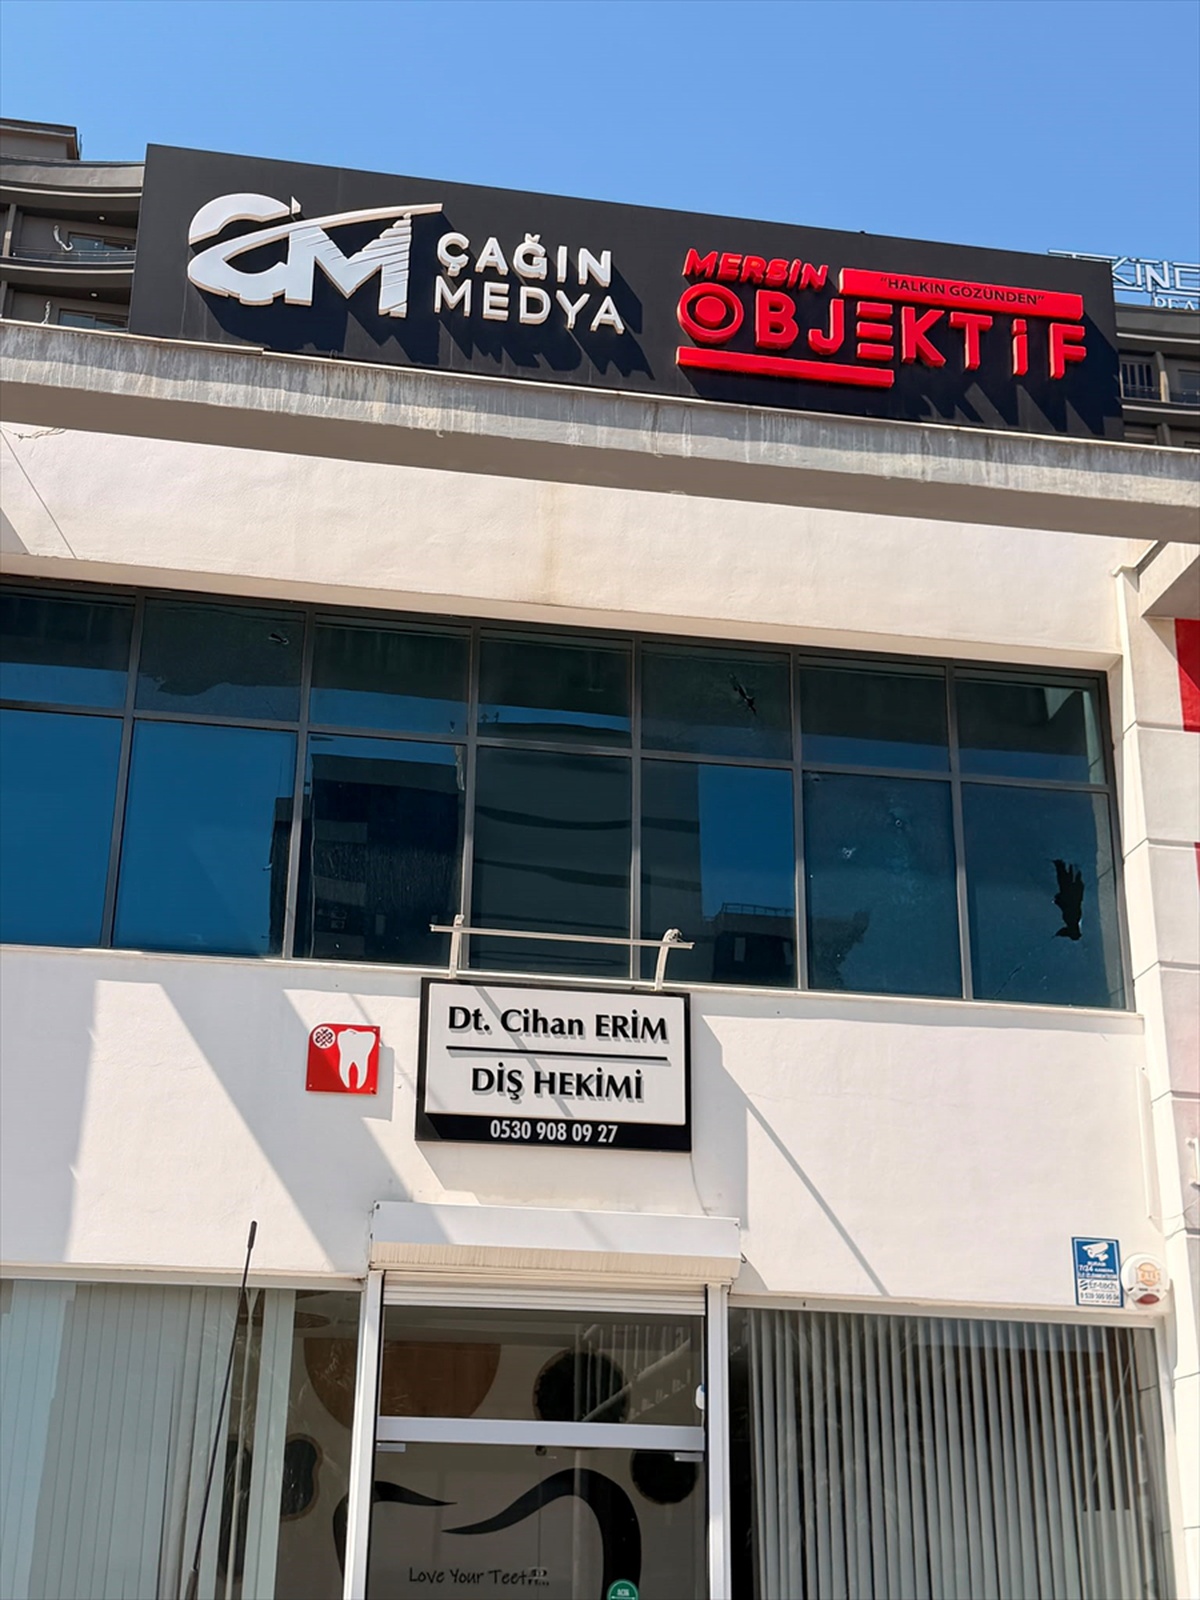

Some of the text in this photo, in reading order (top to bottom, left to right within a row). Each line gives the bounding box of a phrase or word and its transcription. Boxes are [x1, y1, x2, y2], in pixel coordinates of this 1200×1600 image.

[436, 231, 611, 288] ÇAĞIN
[682, 248, 828, 292] MERSİN
[433, 275, 625, 334] MEDYA
[677, 283, 1087, 379] OBJEKTİF
[448, 1005, 668, 1040] Dt. Cihan ERİM
[471, 1061, 643, 1101] DİŞ HEKİMİ
[490, 1119, 618, 1143] 0530 908 09 27
[409, 1567, 446, 1583] Love
[449, 1568, 484, 1585] Your
